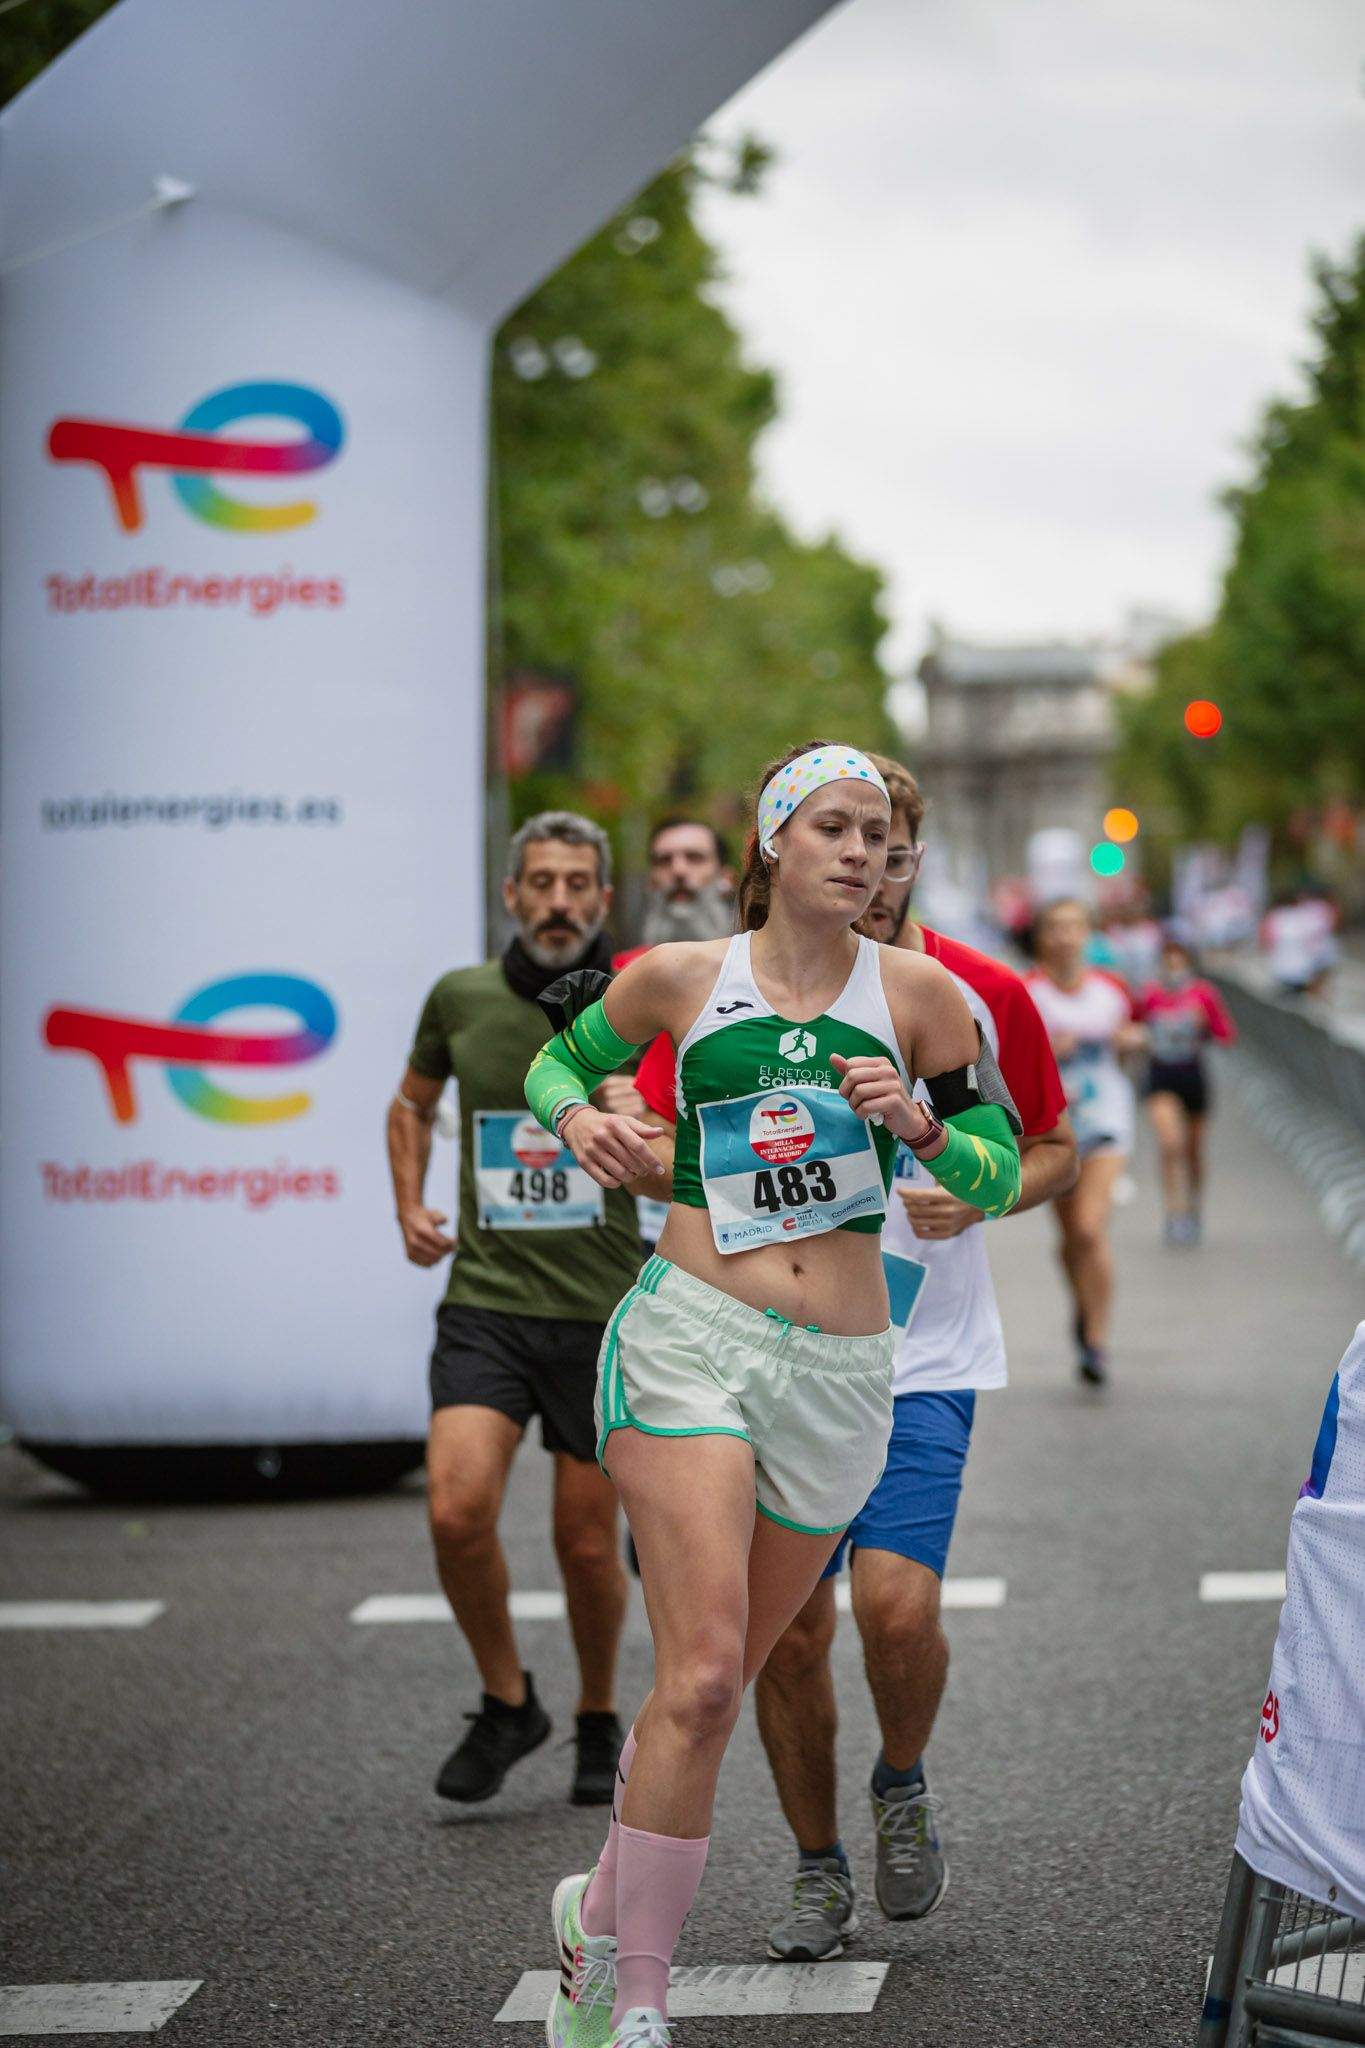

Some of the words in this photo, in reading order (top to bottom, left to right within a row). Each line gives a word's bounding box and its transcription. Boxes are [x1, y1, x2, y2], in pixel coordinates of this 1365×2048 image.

[46, 563, 343, 618] TotalEnergies
[41, 789, 345, 832] totalenergies.es
[759, 1065, 773, 1076] EL
[778, 1067, 812, 1079] RETO
[815, 1070, 832, 1080] DE
[763, 1125, 803, 1136] TotalEnergies
[774, 1139, 794, 1147] MILLA
[778, 1150, 802, 1159] MADRID
[40, 1158, 341, 1212] TotalEnergies
[510, 1169, 568, 1204] 498
[754, 1161, 837, 1213] 483
[734, 1225, 773, 1240] MADRID
